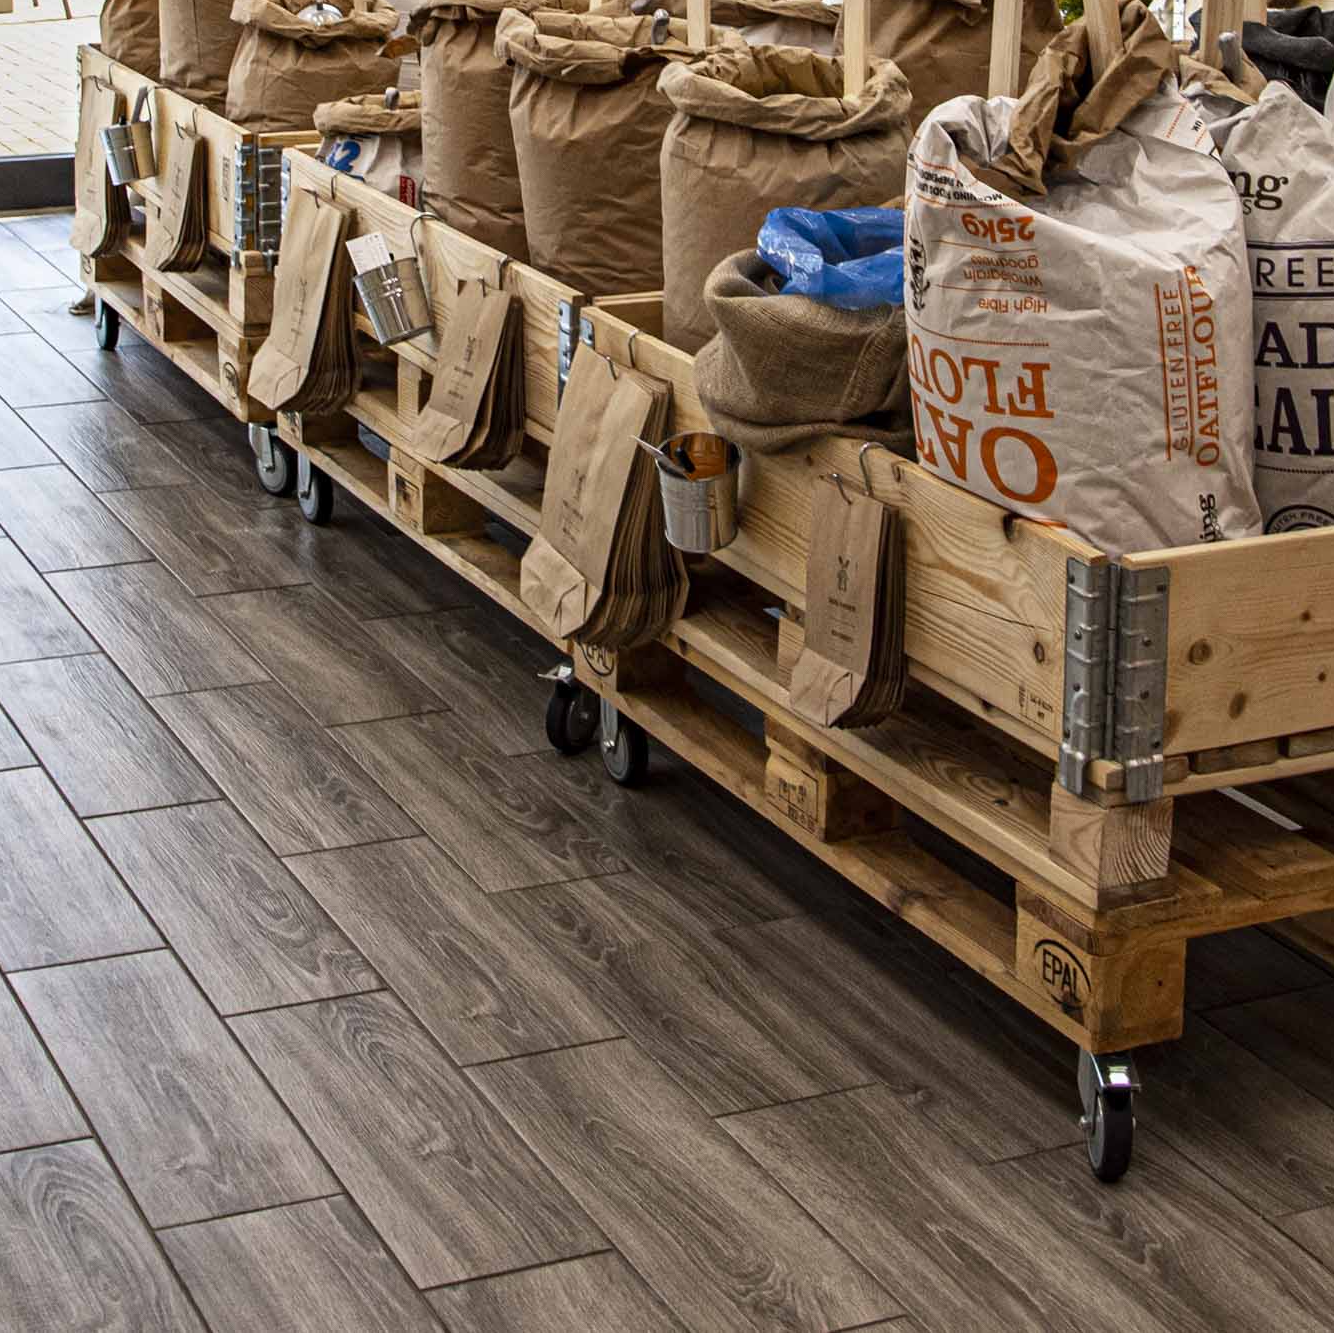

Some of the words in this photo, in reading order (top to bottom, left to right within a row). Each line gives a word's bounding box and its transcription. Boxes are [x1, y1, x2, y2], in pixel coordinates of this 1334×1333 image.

[961, 212, 1036, 247] 25kg
[962, 267, 1043, 288] Wholegrain
[969, 254, 1040, 271] goodness
[977, 297, 1010, 314] Fibre
[1012, 296, 1048, 316] High
[1162, 288, 1184, 348] FREE
[907, 333, 1055, 419] FLOU
[1183, 265, 1221, 467] OATFLOUR
[1169, 357, 1189, 451] GLUTEN
[911, 388, 1058, 504] OAT
